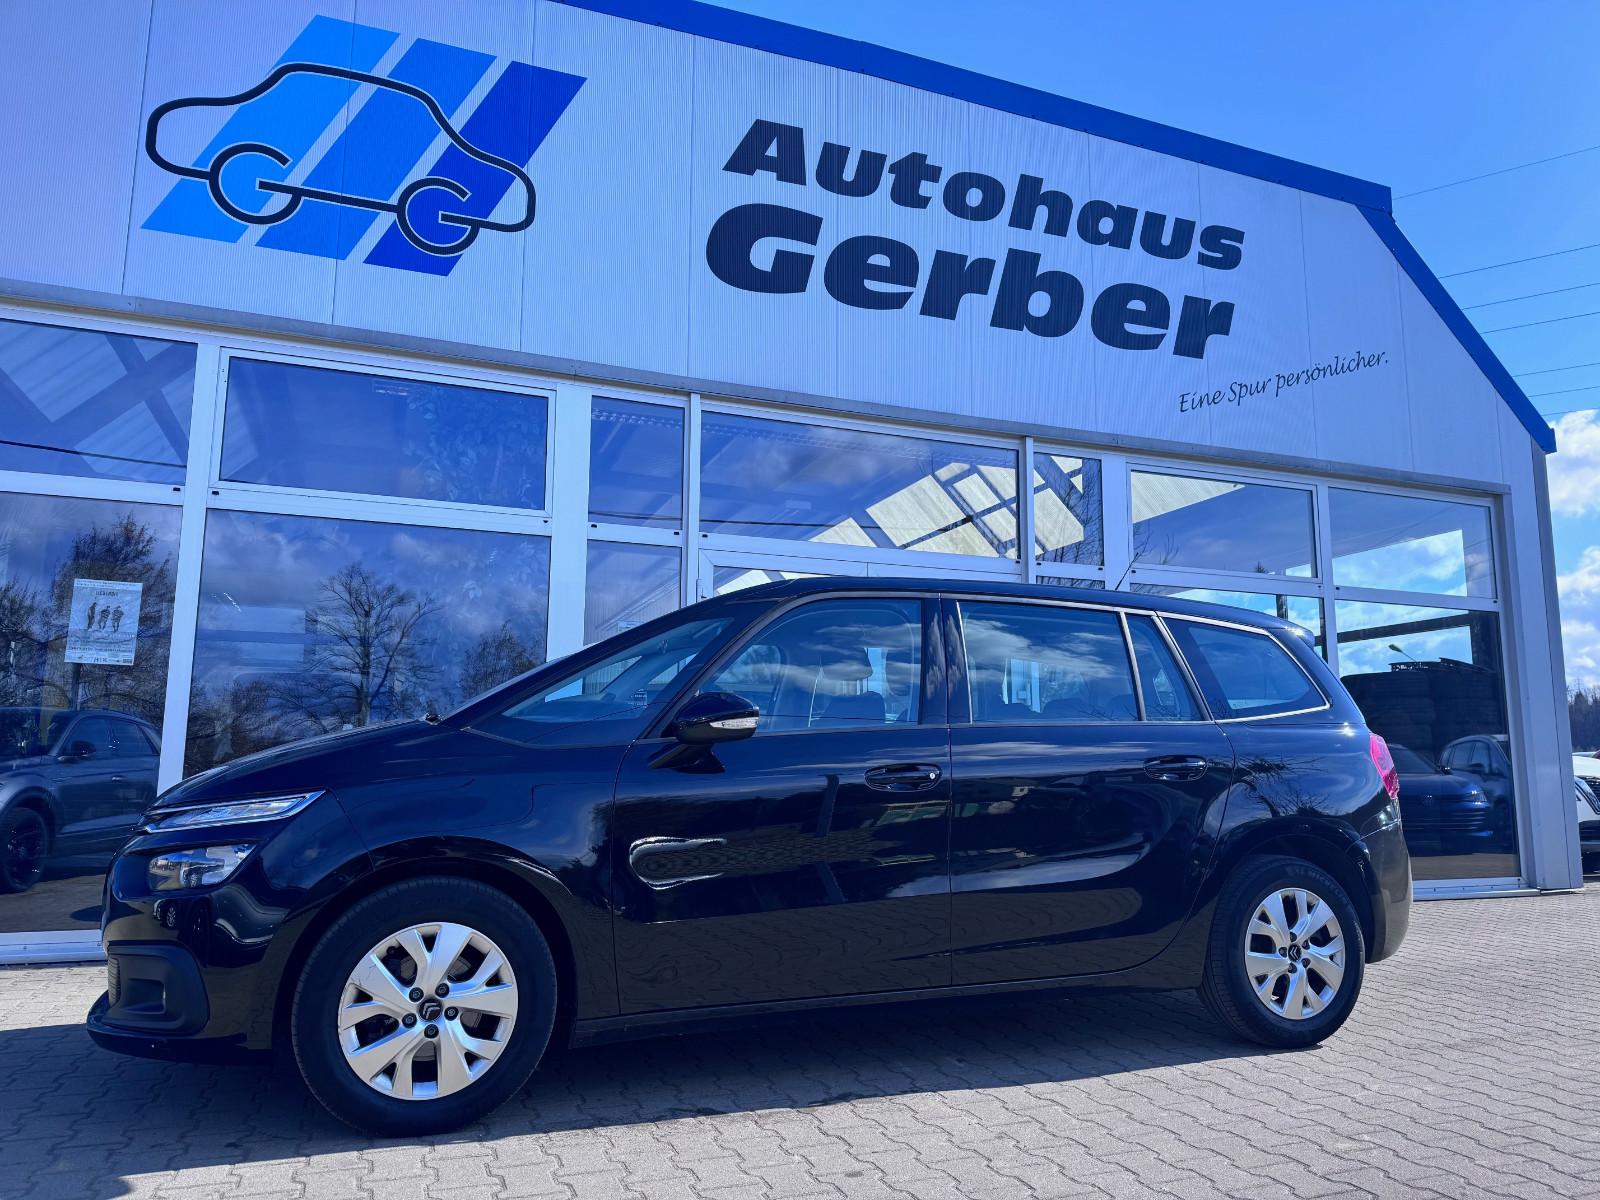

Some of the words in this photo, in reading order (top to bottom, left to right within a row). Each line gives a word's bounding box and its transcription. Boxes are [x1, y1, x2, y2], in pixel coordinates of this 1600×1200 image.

[722, 118, 1246, 271] Autohaus
[705, 203, 1236, 360] Gerber
[1179, 391, 1226, 413] Eine
[1228, 378, 1272, 406] Spur
[1274, 350, 1389, 398] persönlicher.
